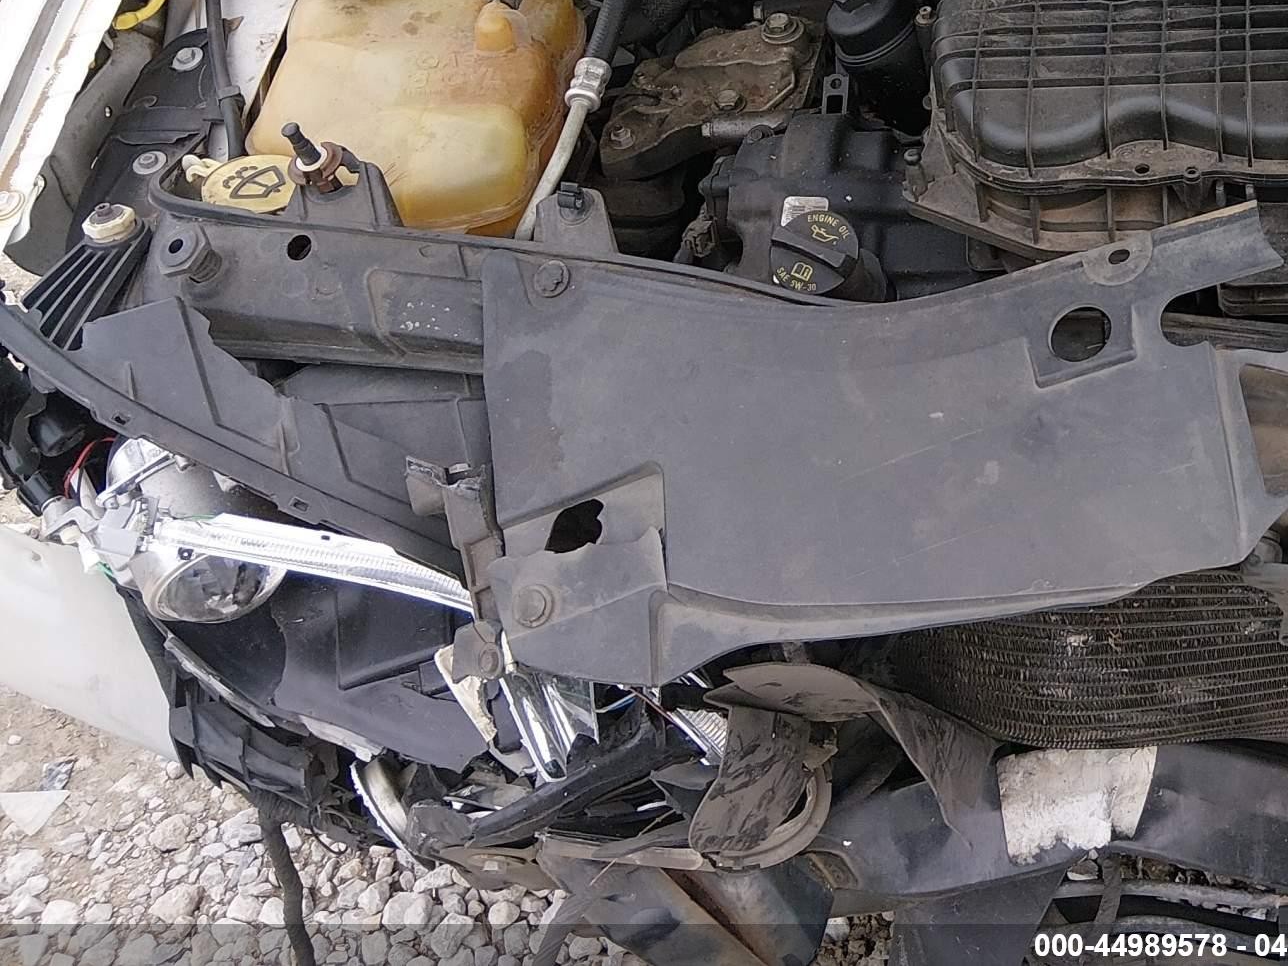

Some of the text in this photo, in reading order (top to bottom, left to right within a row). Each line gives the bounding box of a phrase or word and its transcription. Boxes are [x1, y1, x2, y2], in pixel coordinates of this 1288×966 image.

[807, 213, 851, 240] ENGINE OIL
[776, 266, 817, 292] SAE 5W-30
